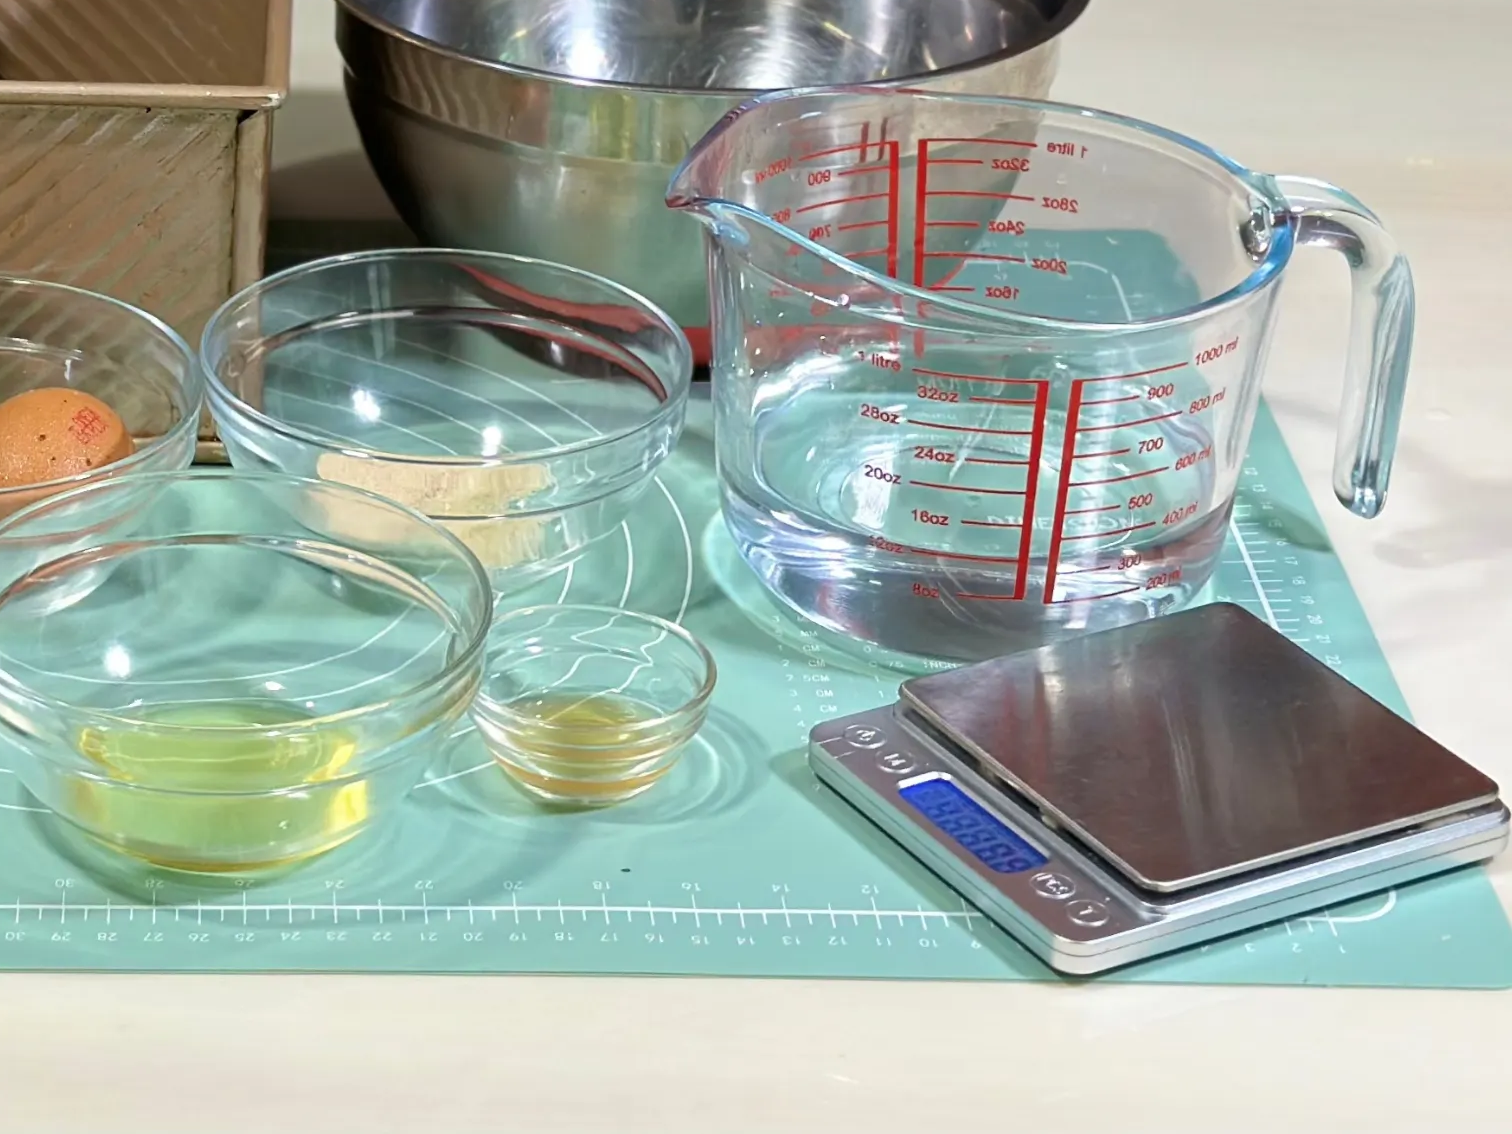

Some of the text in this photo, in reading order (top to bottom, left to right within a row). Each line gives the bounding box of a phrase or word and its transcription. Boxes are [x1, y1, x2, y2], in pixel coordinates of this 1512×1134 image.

[1195, 345, 1223, 365] 1000
[917, 385, 959, 403] 32oz
[1147, 383, 1174, 400] 900
[1189, 395, 1210, 414] 800
[860, 404, 901, 424] 28oz
[1138, 437, 1164, 454] 700
[914, 446, 956, 463] 24oz
[864, 465, 902, 485] 20oz
[1128, 493, 1153, 510] 500
[911, 509, 949, 526] 16oz
[1162, 507, 1182, 526] 400
[1117, 554, 1142, 571] 300
[912, 583, 939, 598] 8oz
